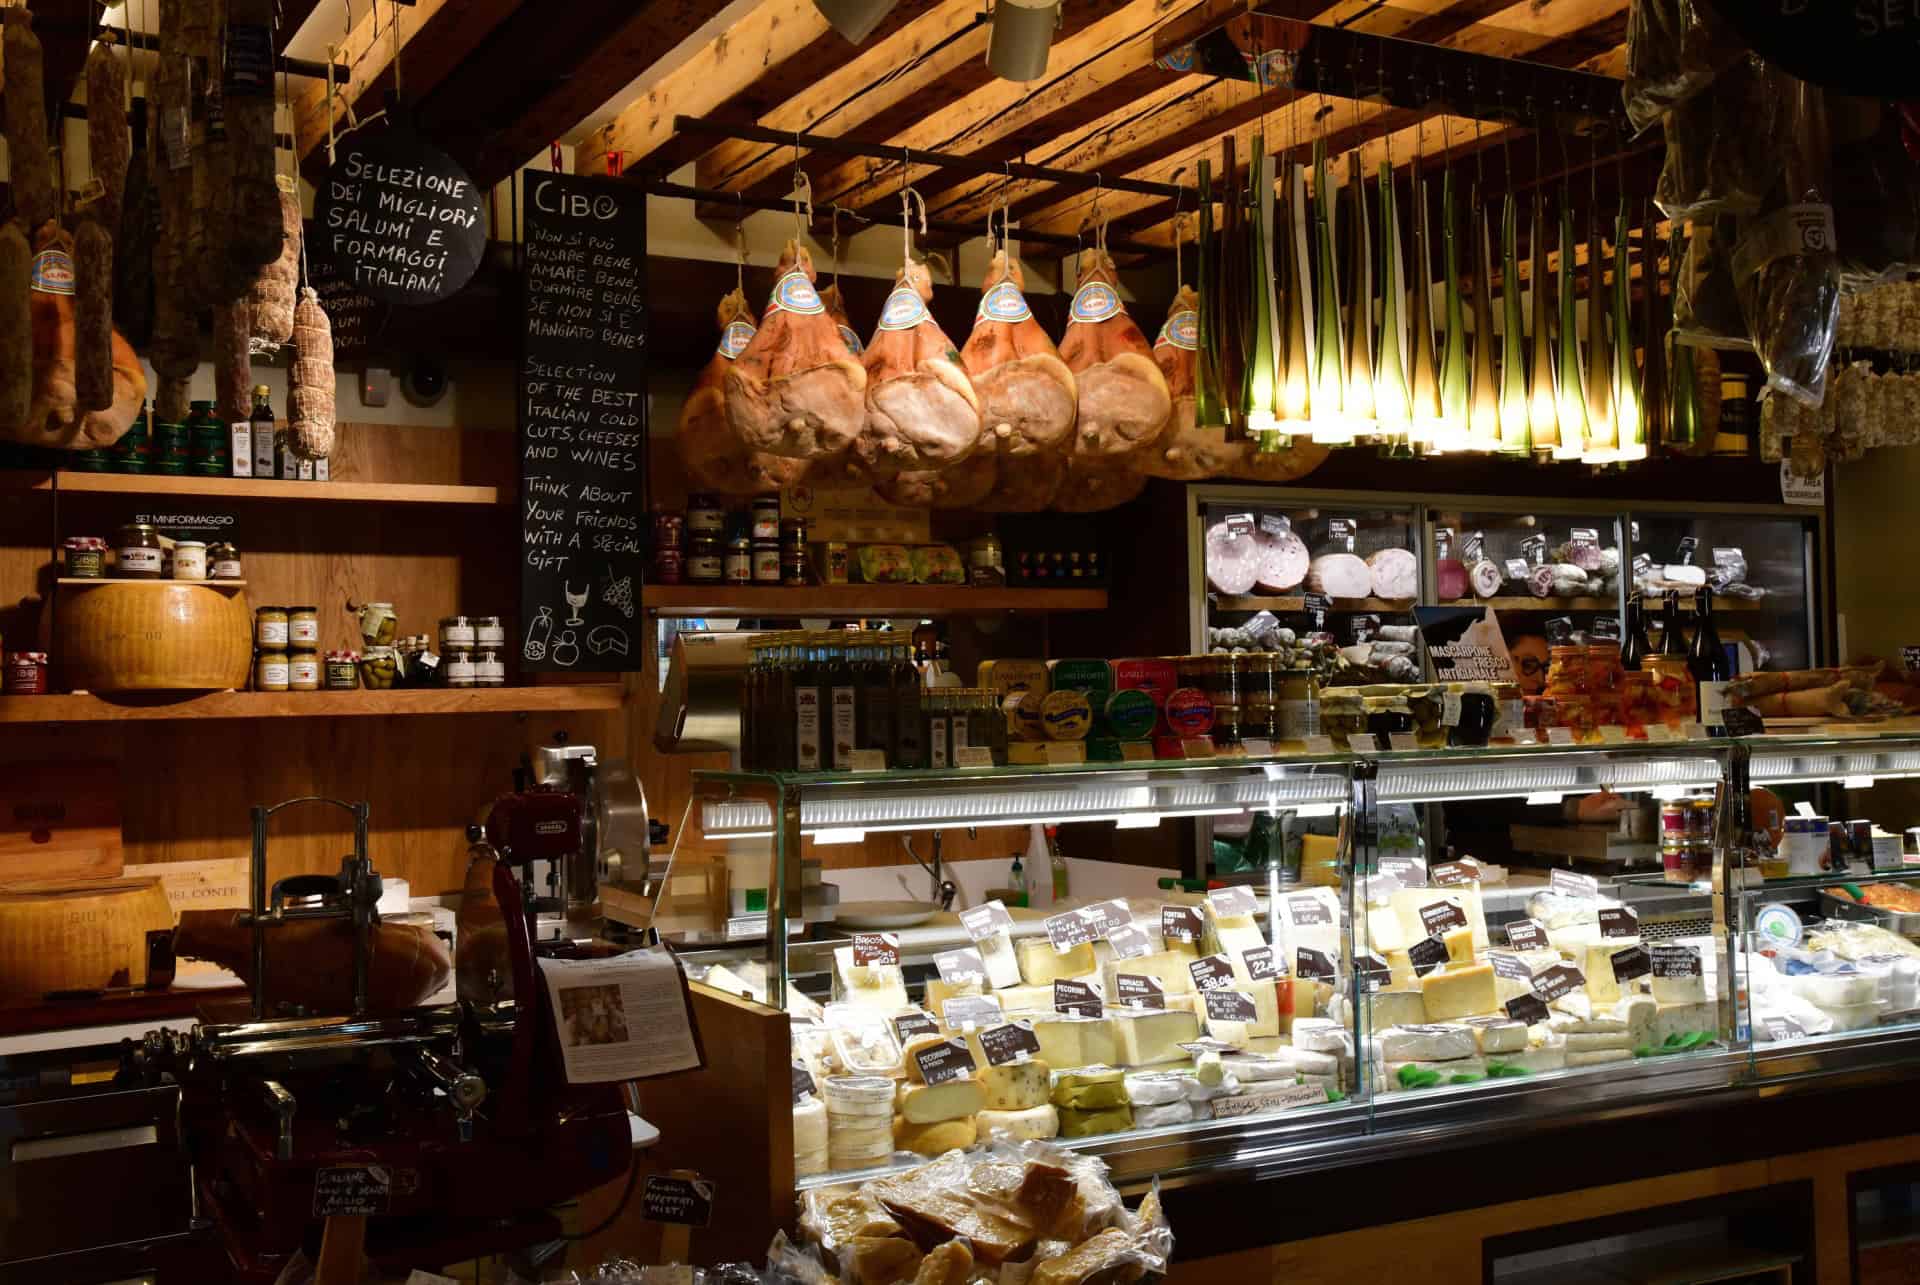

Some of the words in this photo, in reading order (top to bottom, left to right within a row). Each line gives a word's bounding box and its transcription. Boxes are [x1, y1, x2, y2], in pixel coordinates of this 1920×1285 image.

[346, 153, 467, 198] SELEZIONE
[331, 182, 361, 201] DEI
[379, 192, 478, 228] MIGLIORI
[535, 181, 618, 219] CIBO
[328, 208, 414, 239] SALUMI
[427, 230, 443, 247] E
[334, 234, 448, 271] FORMAGGI
[527, 244, 584, 262] PENSARE
[355, 260, 443, 292] ITALIANI
[531, 263, 585, 283] AMARE
[529, 278, 593, 302] DORMIRE
[529, 298, 547, 315] SE
[558, 304, 592, 320] NON
[529, 319, 594, 340] MANGIATO
[525, 355, 616, 384] SELECTION
[528, 382, 548, 395] OF
[555, 384, 583, 401] THE
[592, 389, 638, 407] BEST
[527, 398, 589, 423] ITALIAN
[600, 413, 639, 426] COLD
[527, 426, 574, 442] CUTS,
[578, 431, 640, 448] CHEESES
[525, 446, 558, 459] AND
[571, 448, 636, 471] WINES
[524, 475, 569, 498] THINK
[580, 485, 632, 504] ABOUT
[525, 500, 564, 522] YOUR
[576, 510, 638, 530] FRIENDS
[524, 525, 563, 545] WITH
[568, 531, 581, 548] A
[593, 535, 640, 553] SPECIAL
[527, 550, 569, 572] GIFT
[1429, 645, 1493, 658] MASCARPONE
[1438, 668, 1498, 681] ARTIGIANALE
